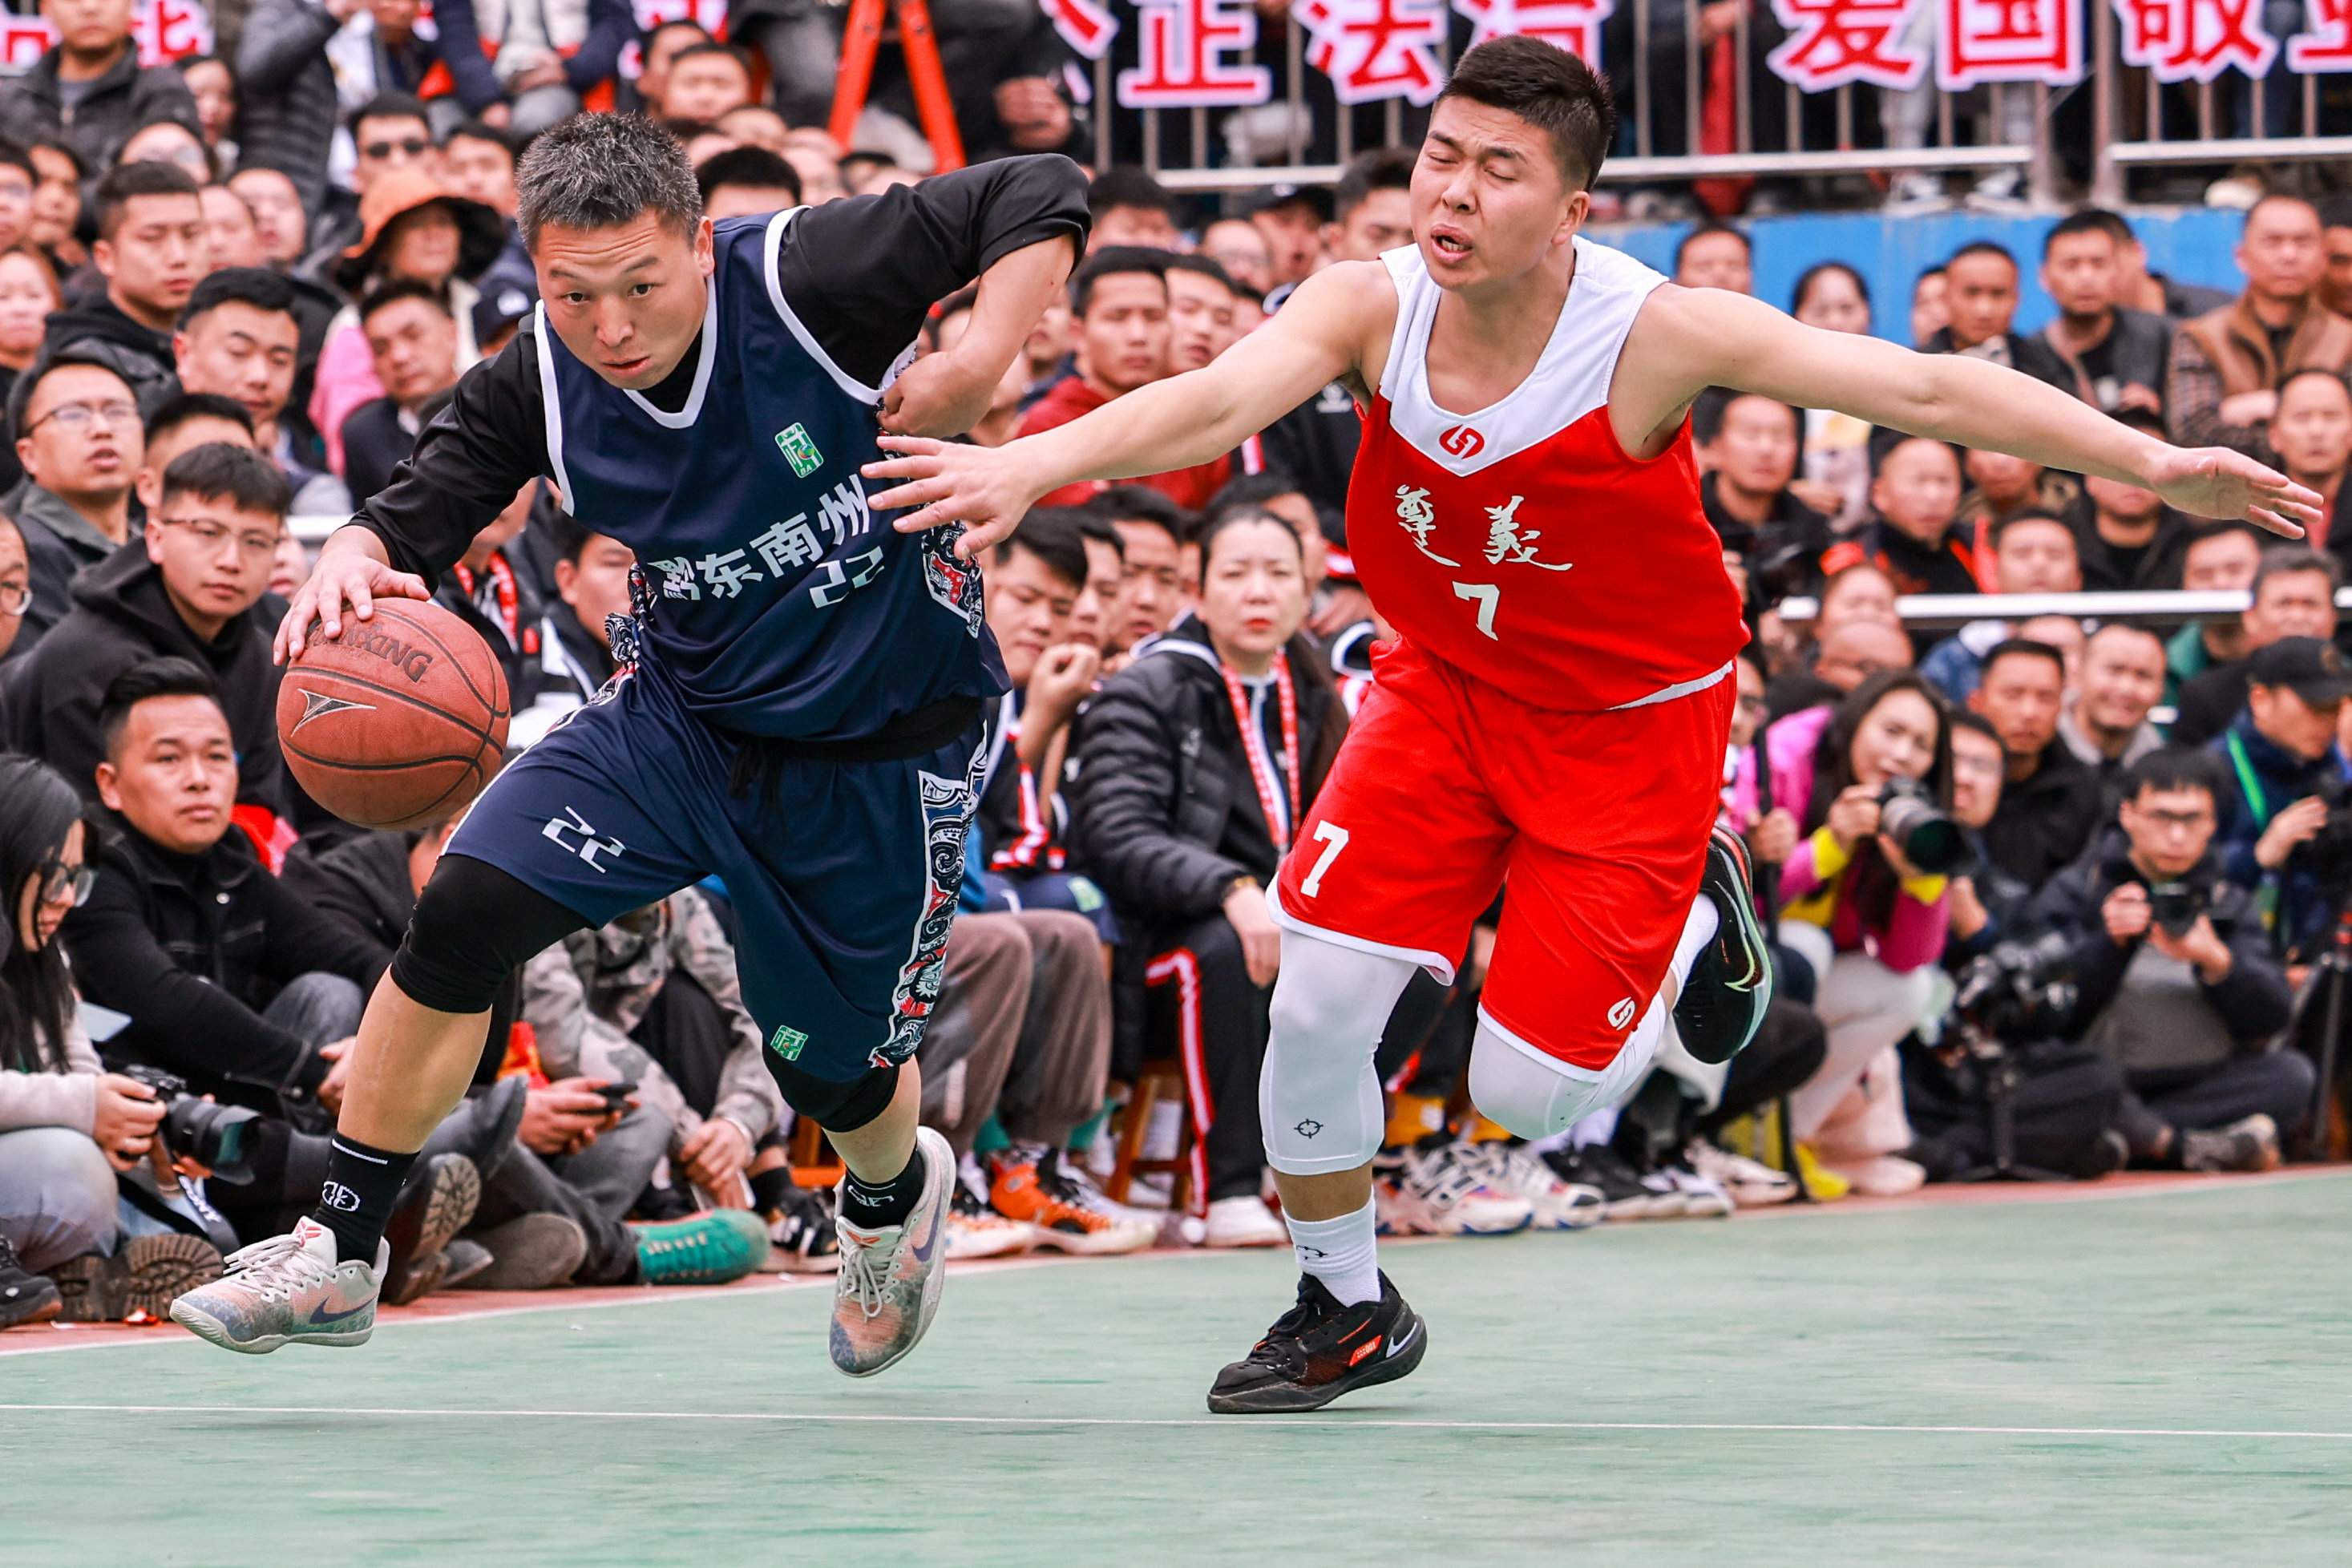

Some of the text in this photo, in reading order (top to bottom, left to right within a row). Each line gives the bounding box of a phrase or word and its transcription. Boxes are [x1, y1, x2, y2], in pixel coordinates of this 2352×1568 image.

[809, 545, 885, 609] 22
[1452, 580, 1501, 641] 7
[1299, 818, 1350, 899] 7
